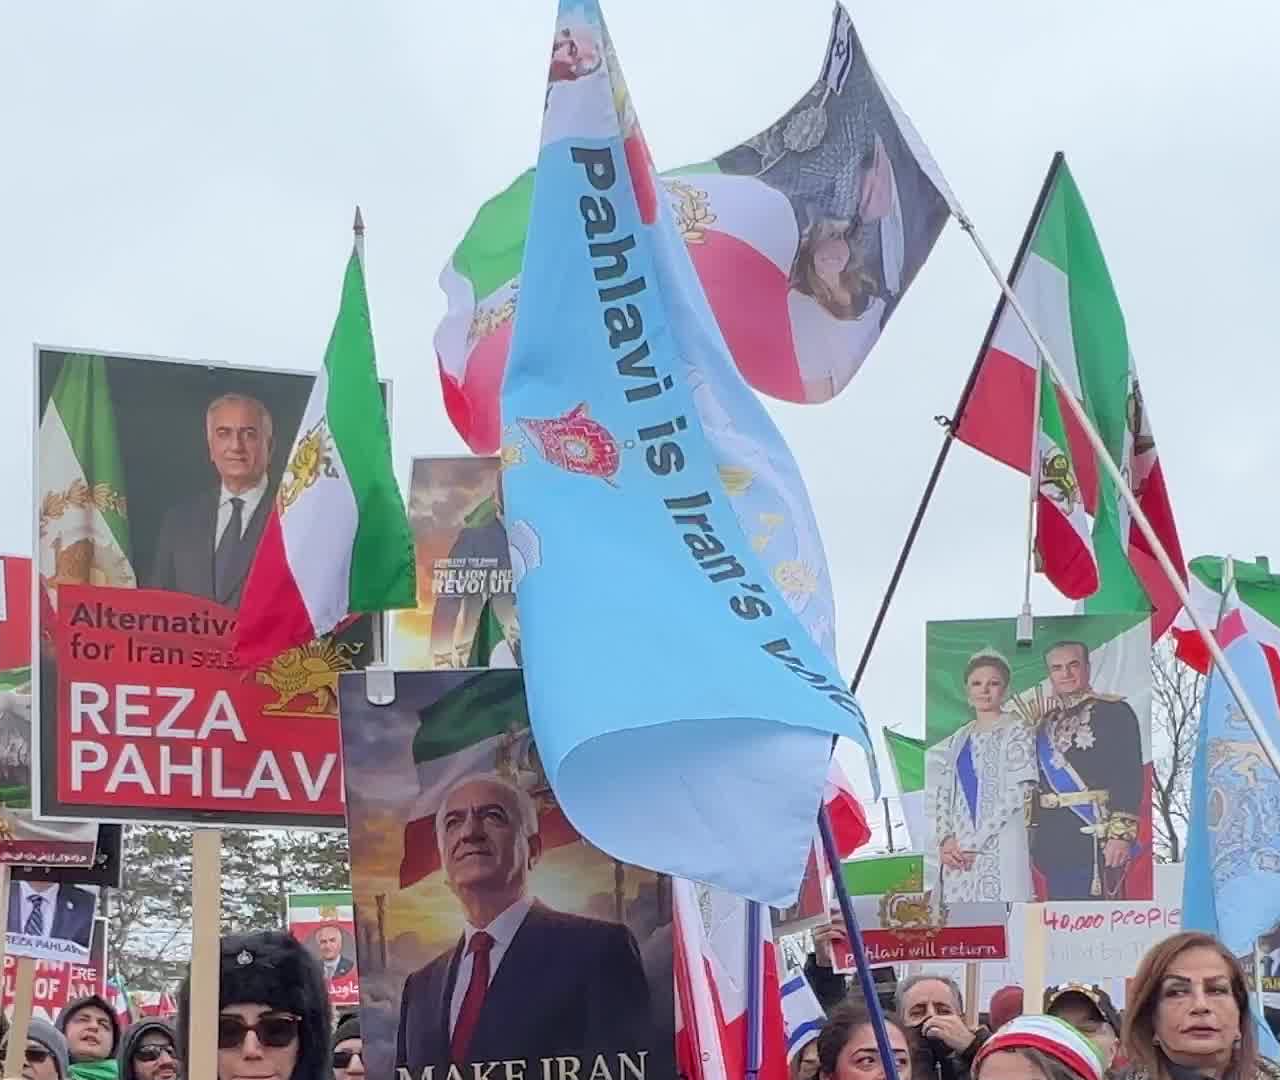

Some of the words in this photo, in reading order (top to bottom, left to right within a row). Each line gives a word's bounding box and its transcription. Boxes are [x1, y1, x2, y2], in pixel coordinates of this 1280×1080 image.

[570, 146, 674, 402] Pahlavi
[637, 415, 687, 477] is
[664, 491, 773, 622] Iran's
[70, 632, 115, 661] for
[127, 636, 184, 665] Iran
[70, 681, 248, 743] REZA
[70, 742, 345, 804] PAHLAV
[1043, 907, 1105, 933] 40,000
[908, 941, 937, 958] will
[940, 941, 998, 956] return
